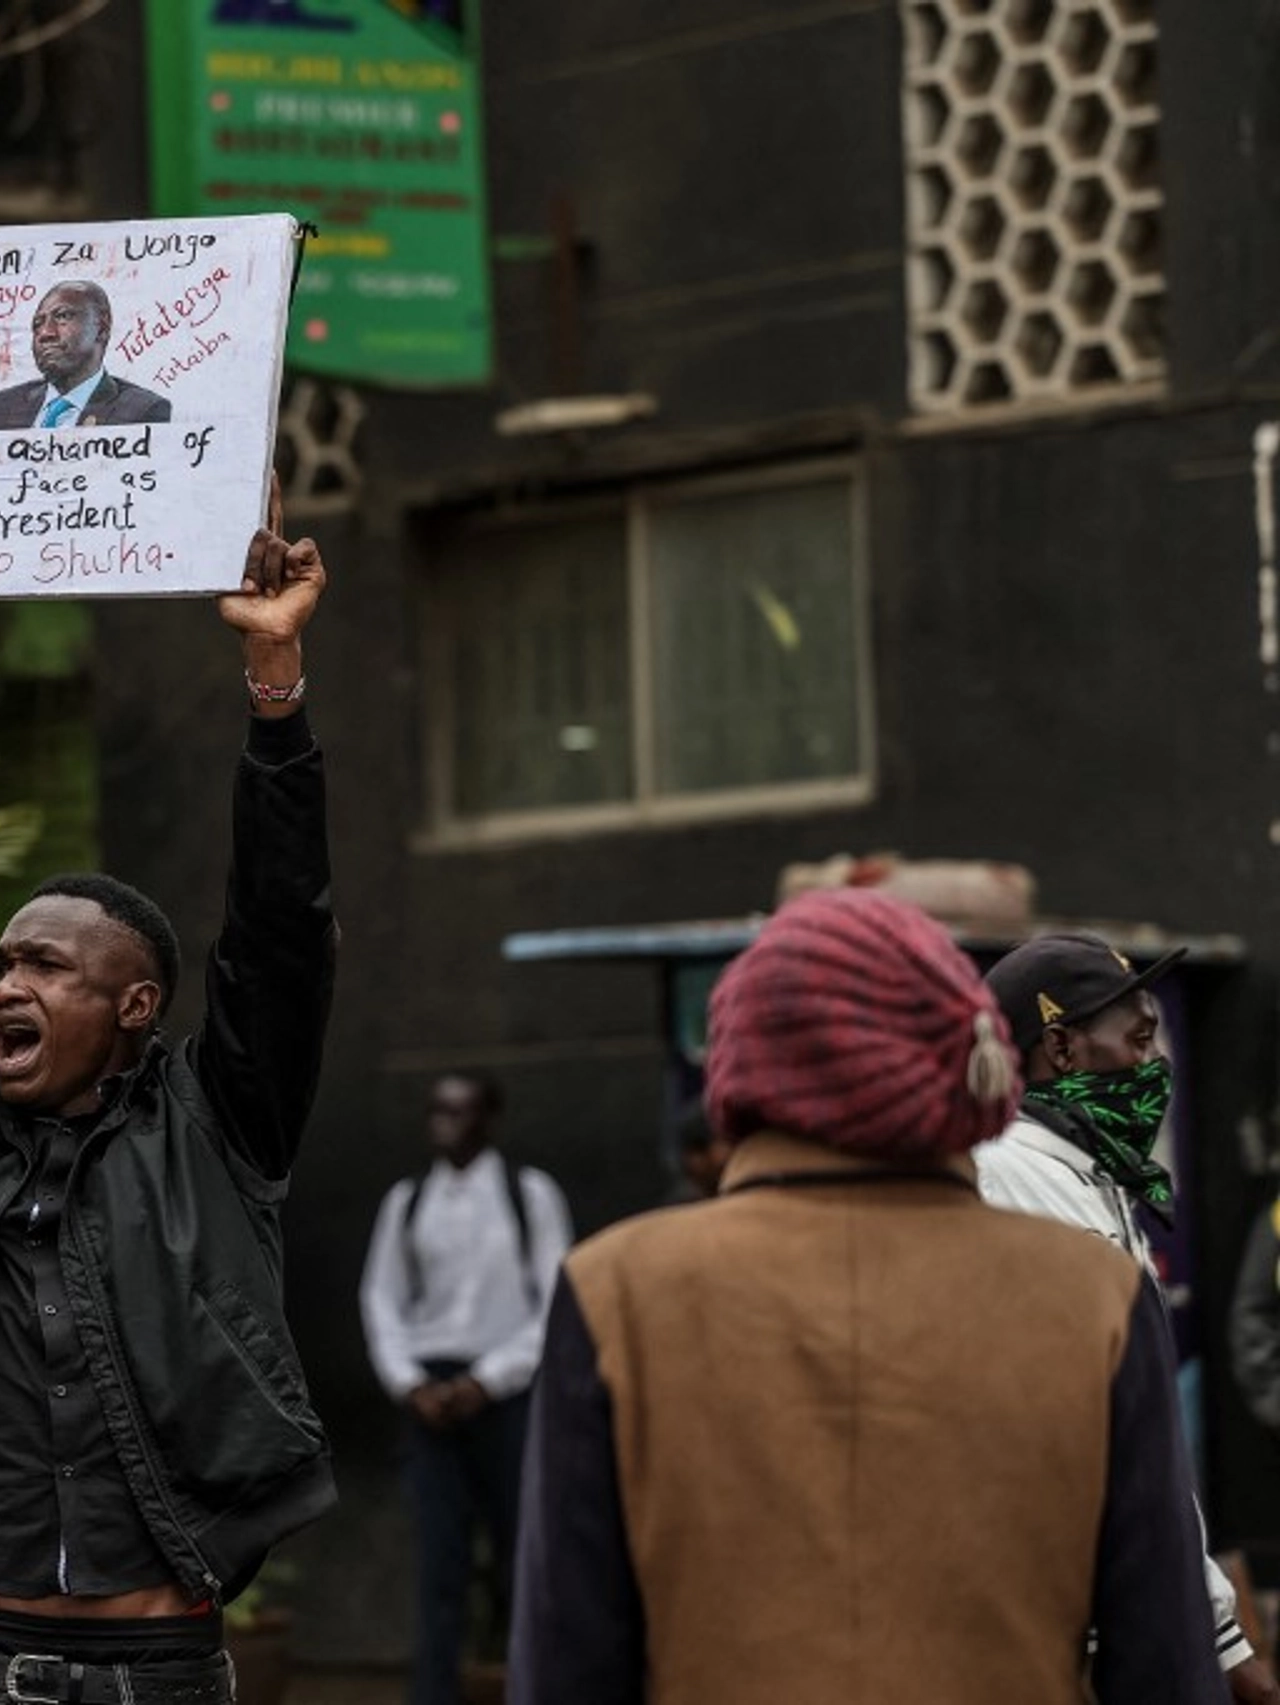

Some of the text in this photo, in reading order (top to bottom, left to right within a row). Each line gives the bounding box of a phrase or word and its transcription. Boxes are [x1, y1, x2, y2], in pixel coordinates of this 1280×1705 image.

[7, 425, 151, 462] ashamed
[183, 426, 215, 468] of
[8, 468, 88, 505] face
[120, 470, 157, 492] as
